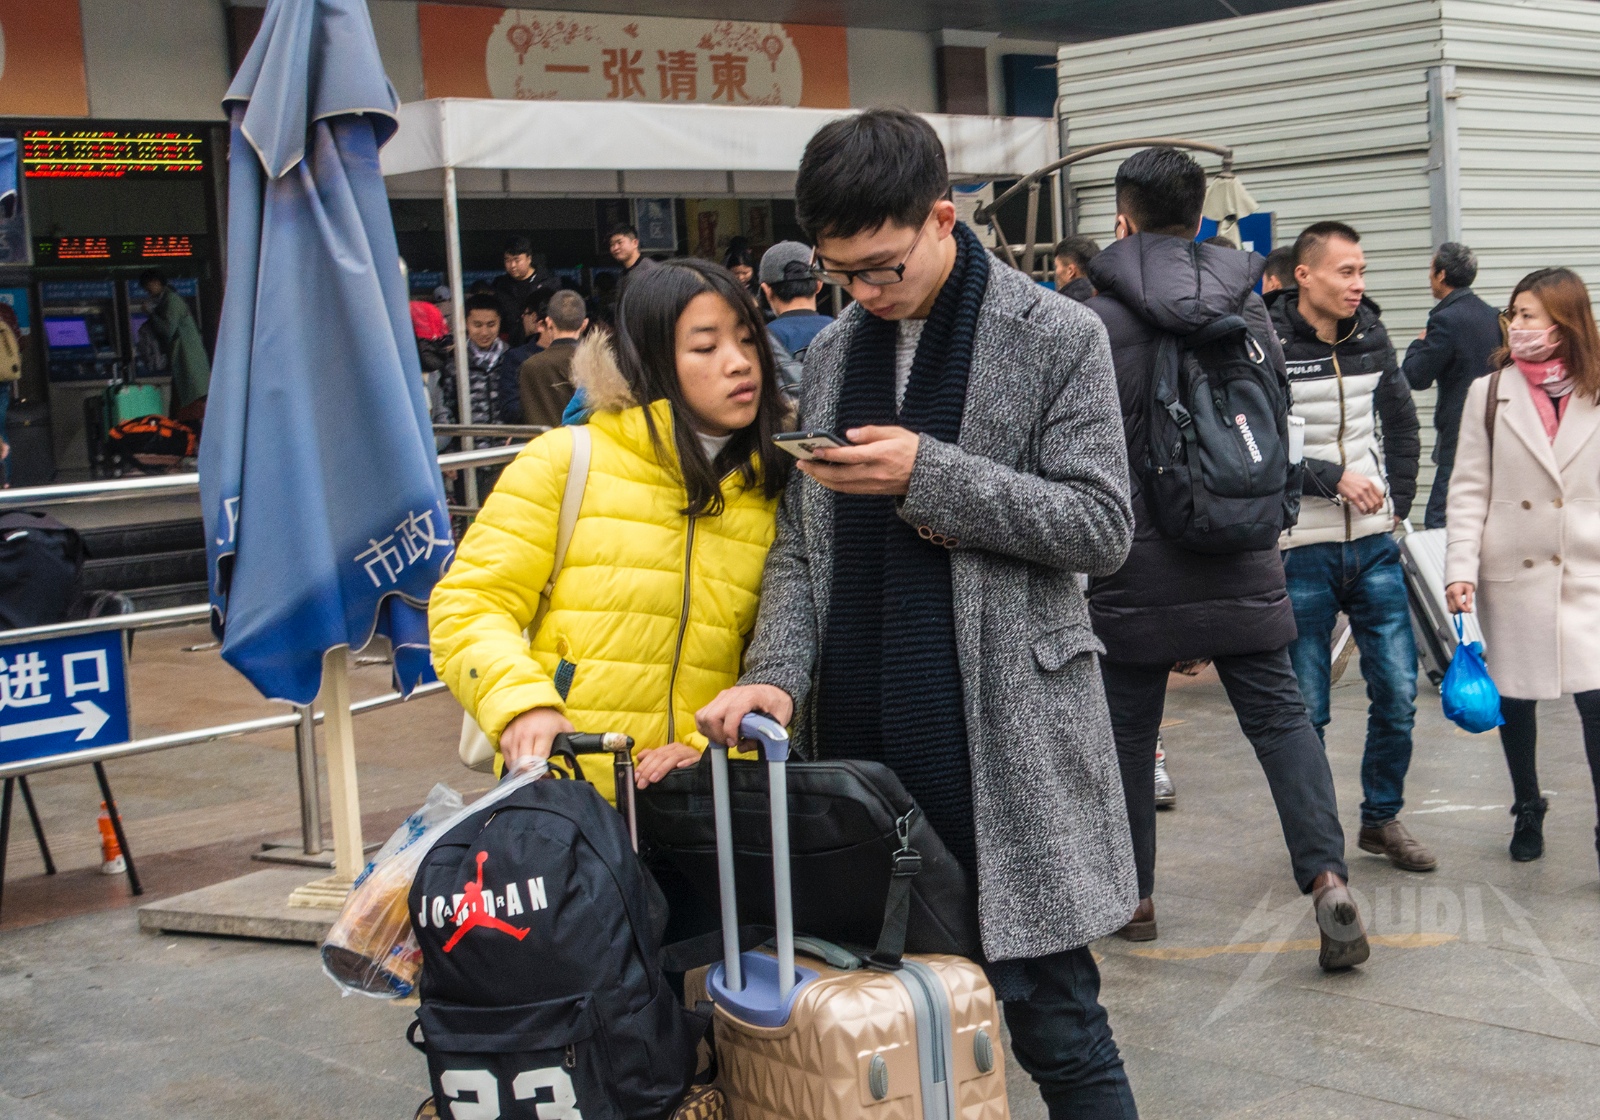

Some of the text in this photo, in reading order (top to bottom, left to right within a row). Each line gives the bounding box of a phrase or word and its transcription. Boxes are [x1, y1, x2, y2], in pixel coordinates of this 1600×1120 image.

[544, 48, 750, 101] 一张请柬
[1239, 421, 1263, 464] WENGER
[353, 500, 456, 588] 市政
[0, 648, 110, 712] 进口
[418, 876, 548, 929] JORDAN
[440, 1066, 584, 1120] 23
